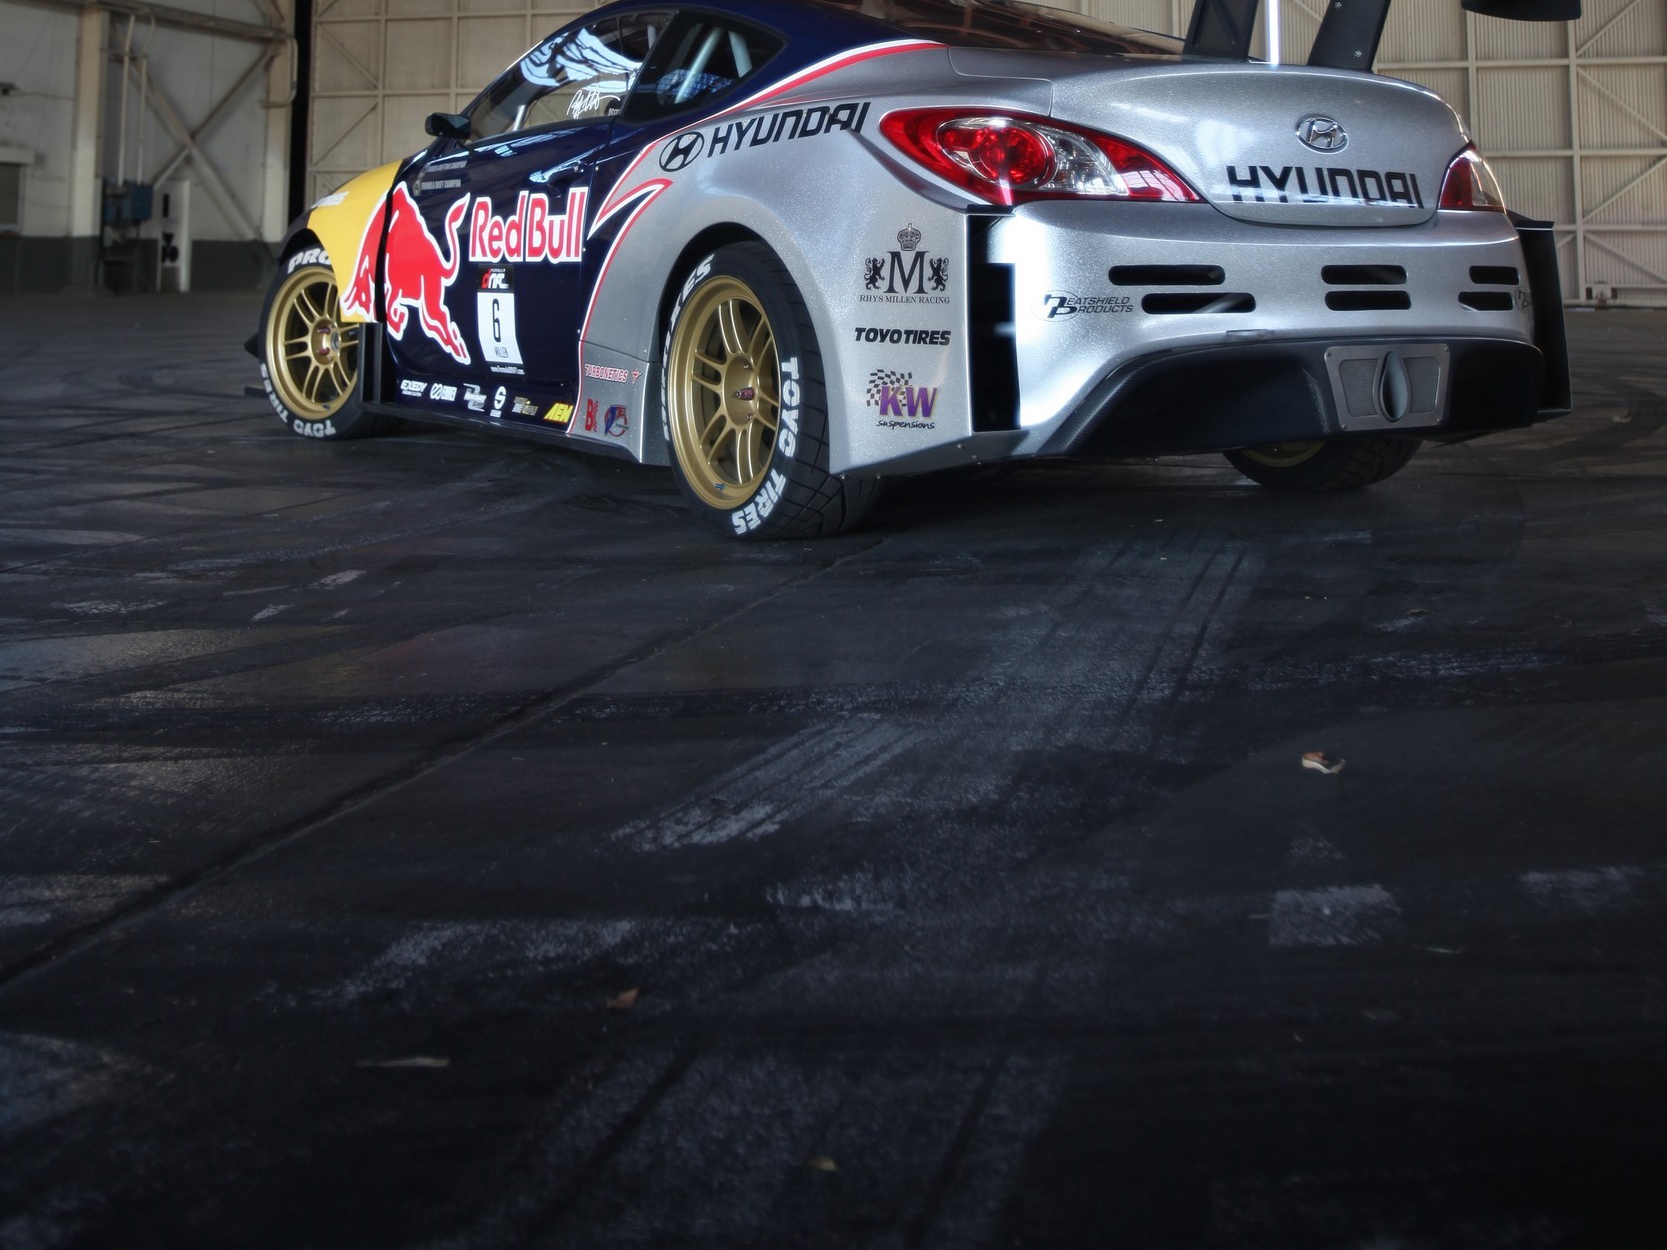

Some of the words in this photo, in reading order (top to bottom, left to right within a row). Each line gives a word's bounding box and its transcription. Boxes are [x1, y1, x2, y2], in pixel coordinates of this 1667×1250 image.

[707, 101, 872, 159] HYUNDAI
[1226, 165, 1425, 210] HYUNDAI
[469, 191, 529, 262] Red
[525, 187, 589, 264] Bull
[883, 251, 930, 295] M
[918, 296, 950, 305] RACING
[492, 298, 502, 343] 6
[855, 327, 903, 344] TOYO
[903, 329, 952, 346] TIRES
[400, 380, 427, 392] EXEDY
[585, 364, 628, 383] TURBONETICS
[544, 402, 574, 423] AEM
[778, 357, 800, 458] TOYO
[880, 385, 938, 418] KW
[293, 419, 337, 438] TOYO
[876, 420, 935, 430] suspensions
[731, 468, 787, 535] TIRES
